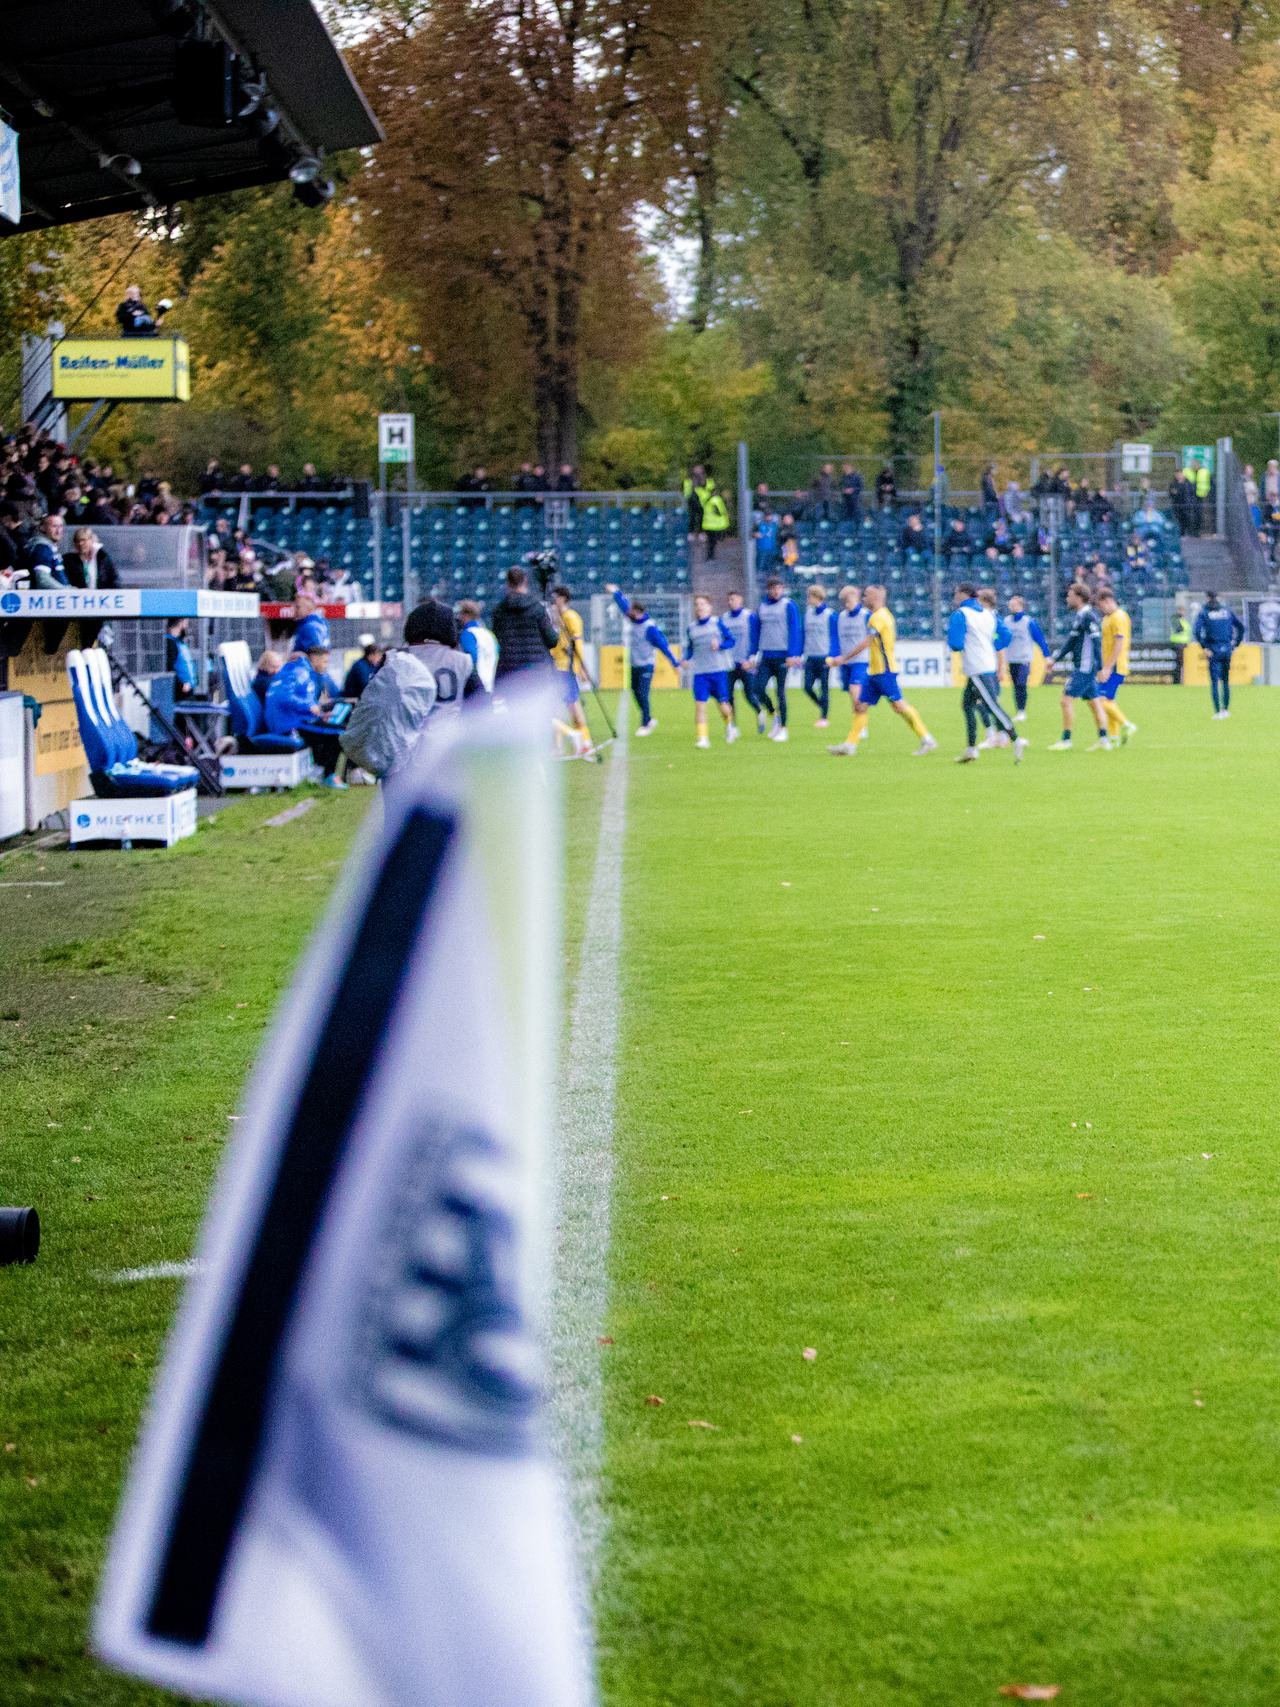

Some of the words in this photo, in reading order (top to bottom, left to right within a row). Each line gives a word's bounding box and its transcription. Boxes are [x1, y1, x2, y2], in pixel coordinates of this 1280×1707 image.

[59, 355, 164, 369] Reifen-Müller
[387, 427, 405, 445] H
[28, 595, 126, 611] MIETHKE
[896, 657, 940, 676] GA
[238, 767, 292, 777] MIETHKE
[96, 814, 166, 826] MIETHKE
